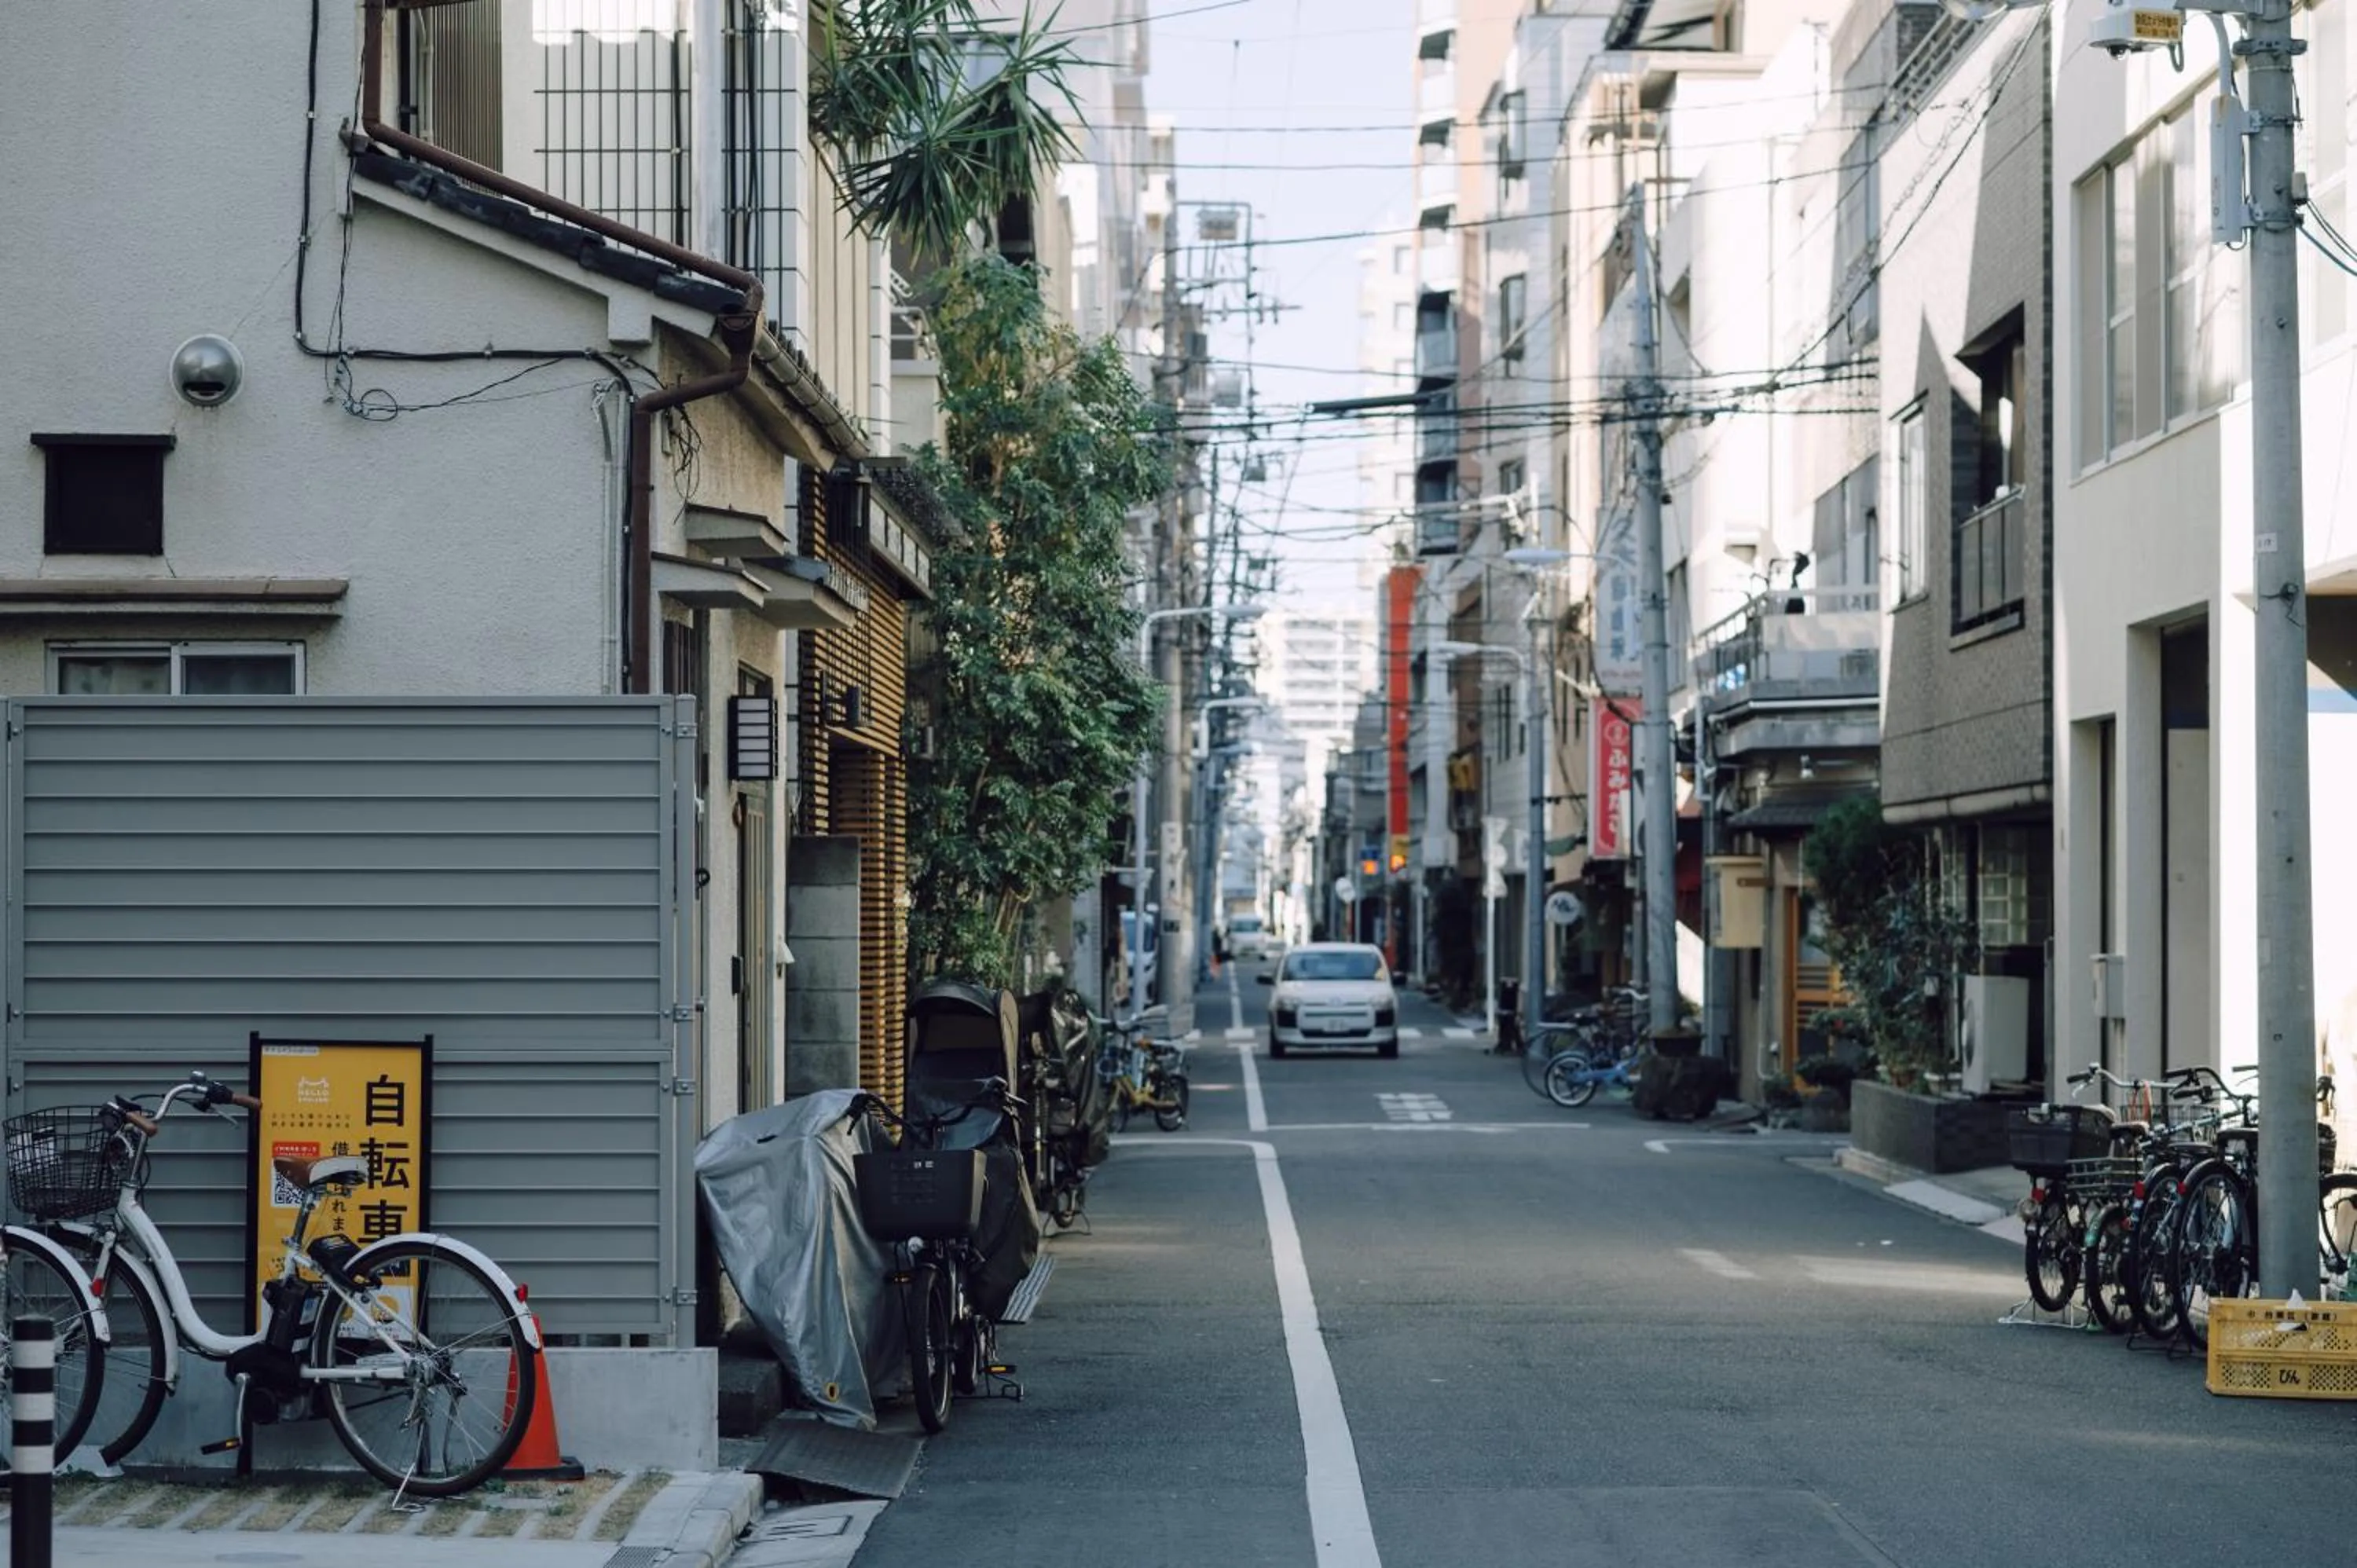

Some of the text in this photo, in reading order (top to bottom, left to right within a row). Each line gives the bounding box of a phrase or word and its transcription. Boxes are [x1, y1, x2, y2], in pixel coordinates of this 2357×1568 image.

[358, 1075, 409, 1243] 自転車
[2278, 1368, 2301, 1385] びん
